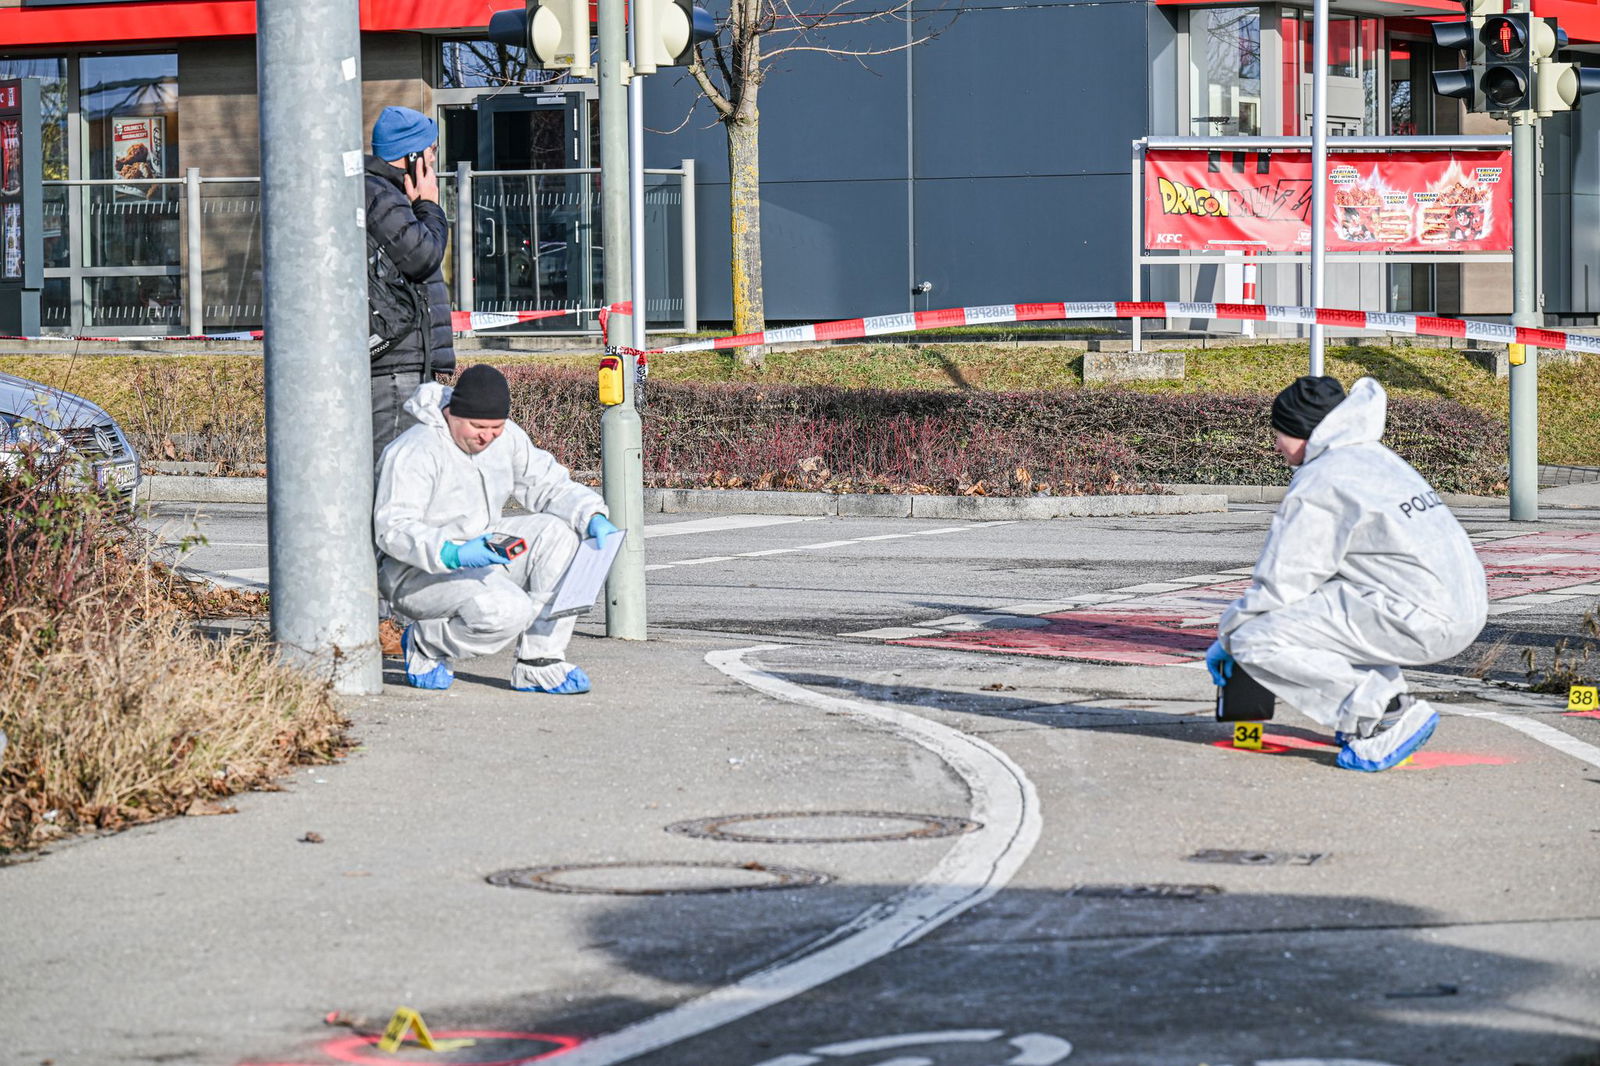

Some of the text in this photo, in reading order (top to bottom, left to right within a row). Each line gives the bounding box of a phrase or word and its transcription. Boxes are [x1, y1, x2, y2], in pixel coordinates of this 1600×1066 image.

[1156, 234, 1182, 243] KFC
[1571, 690, 1593, 705] 38
[1236, 726, 1260, 743] 34
